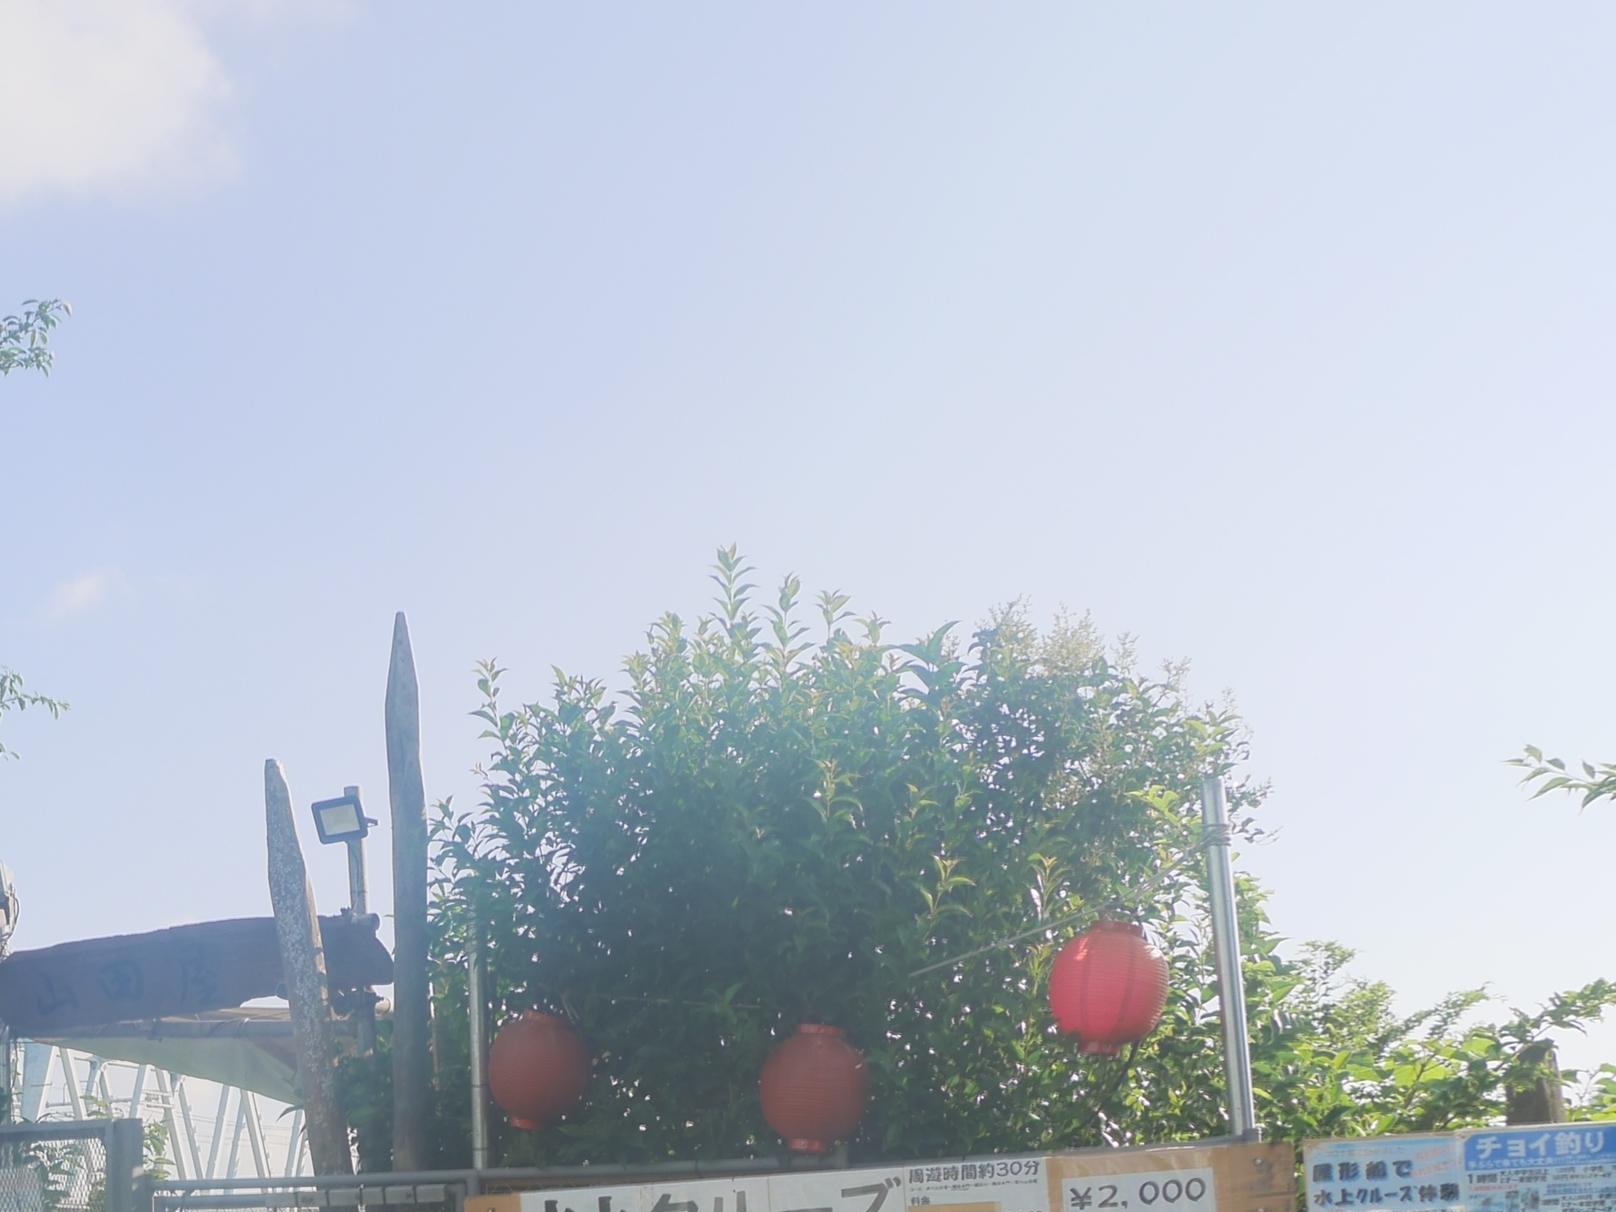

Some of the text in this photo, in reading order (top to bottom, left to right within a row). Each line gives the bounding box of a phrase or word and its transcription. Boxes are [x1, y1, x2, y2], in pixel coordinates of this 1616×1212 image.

[1476, 1131, 1604, 1159] チョイ釣り
[909, 1160, 1040, 1184] 周遊時間約30分
[910, 1196, 930, 1206] 料金
